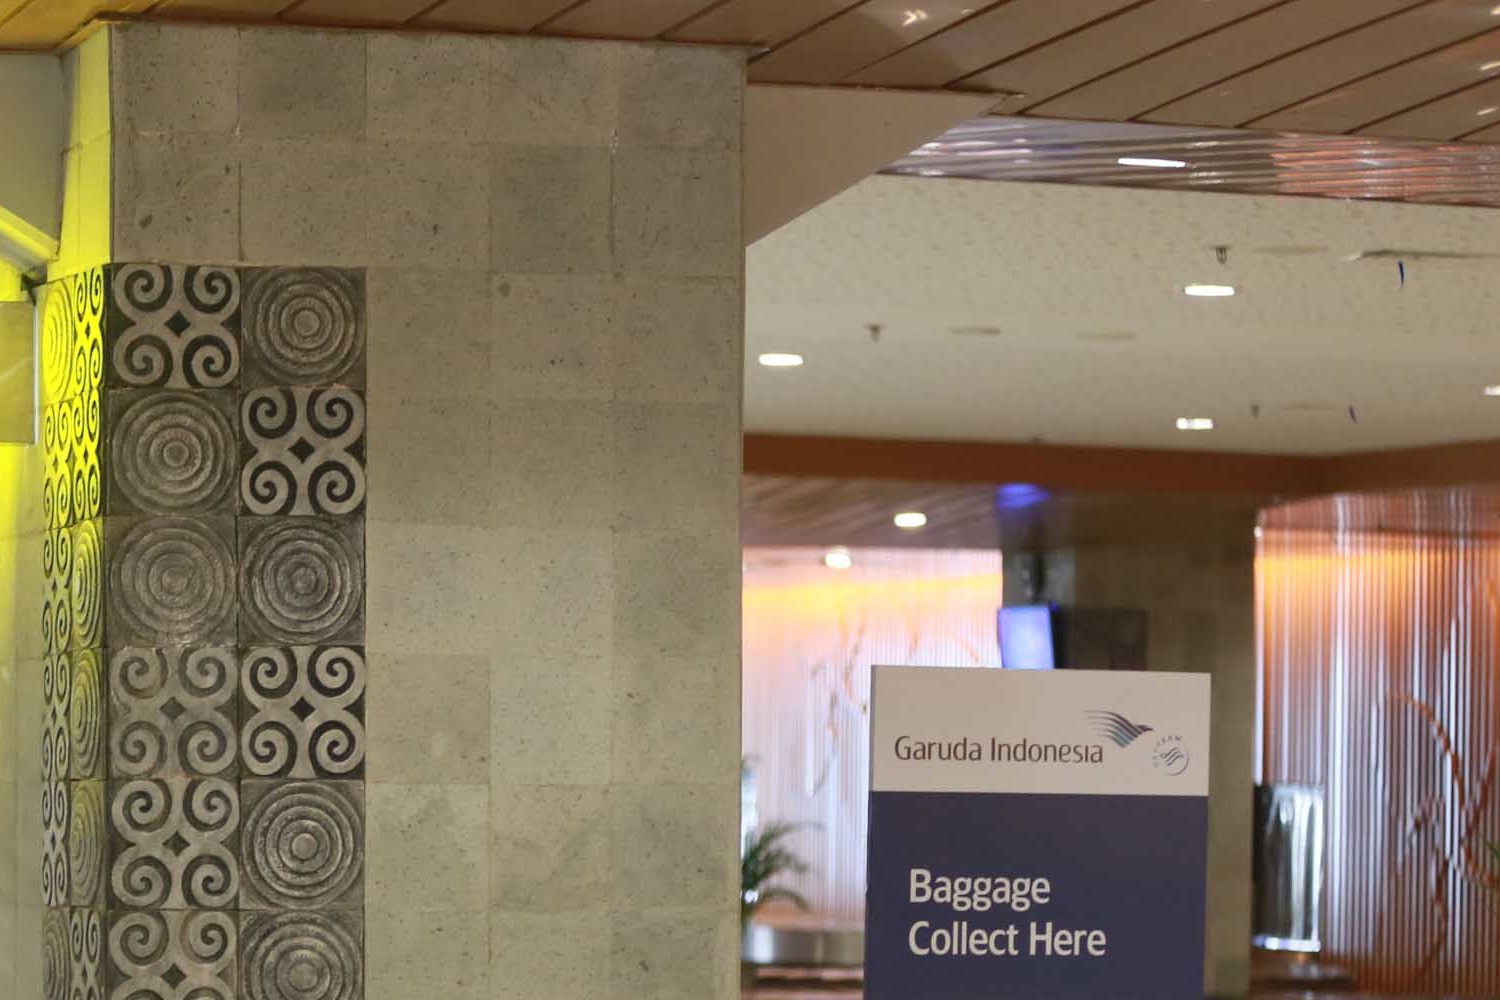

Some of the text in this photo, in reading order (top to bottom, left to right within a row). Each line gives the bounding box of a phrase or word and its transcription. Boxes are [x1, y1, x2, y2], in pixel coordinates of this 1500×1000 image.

[894, 735, 1104, 764] Garuda Indonesia
[909, 868, 1051, 912] Baggage
[908, 920, 1107, 957] Collect Here
